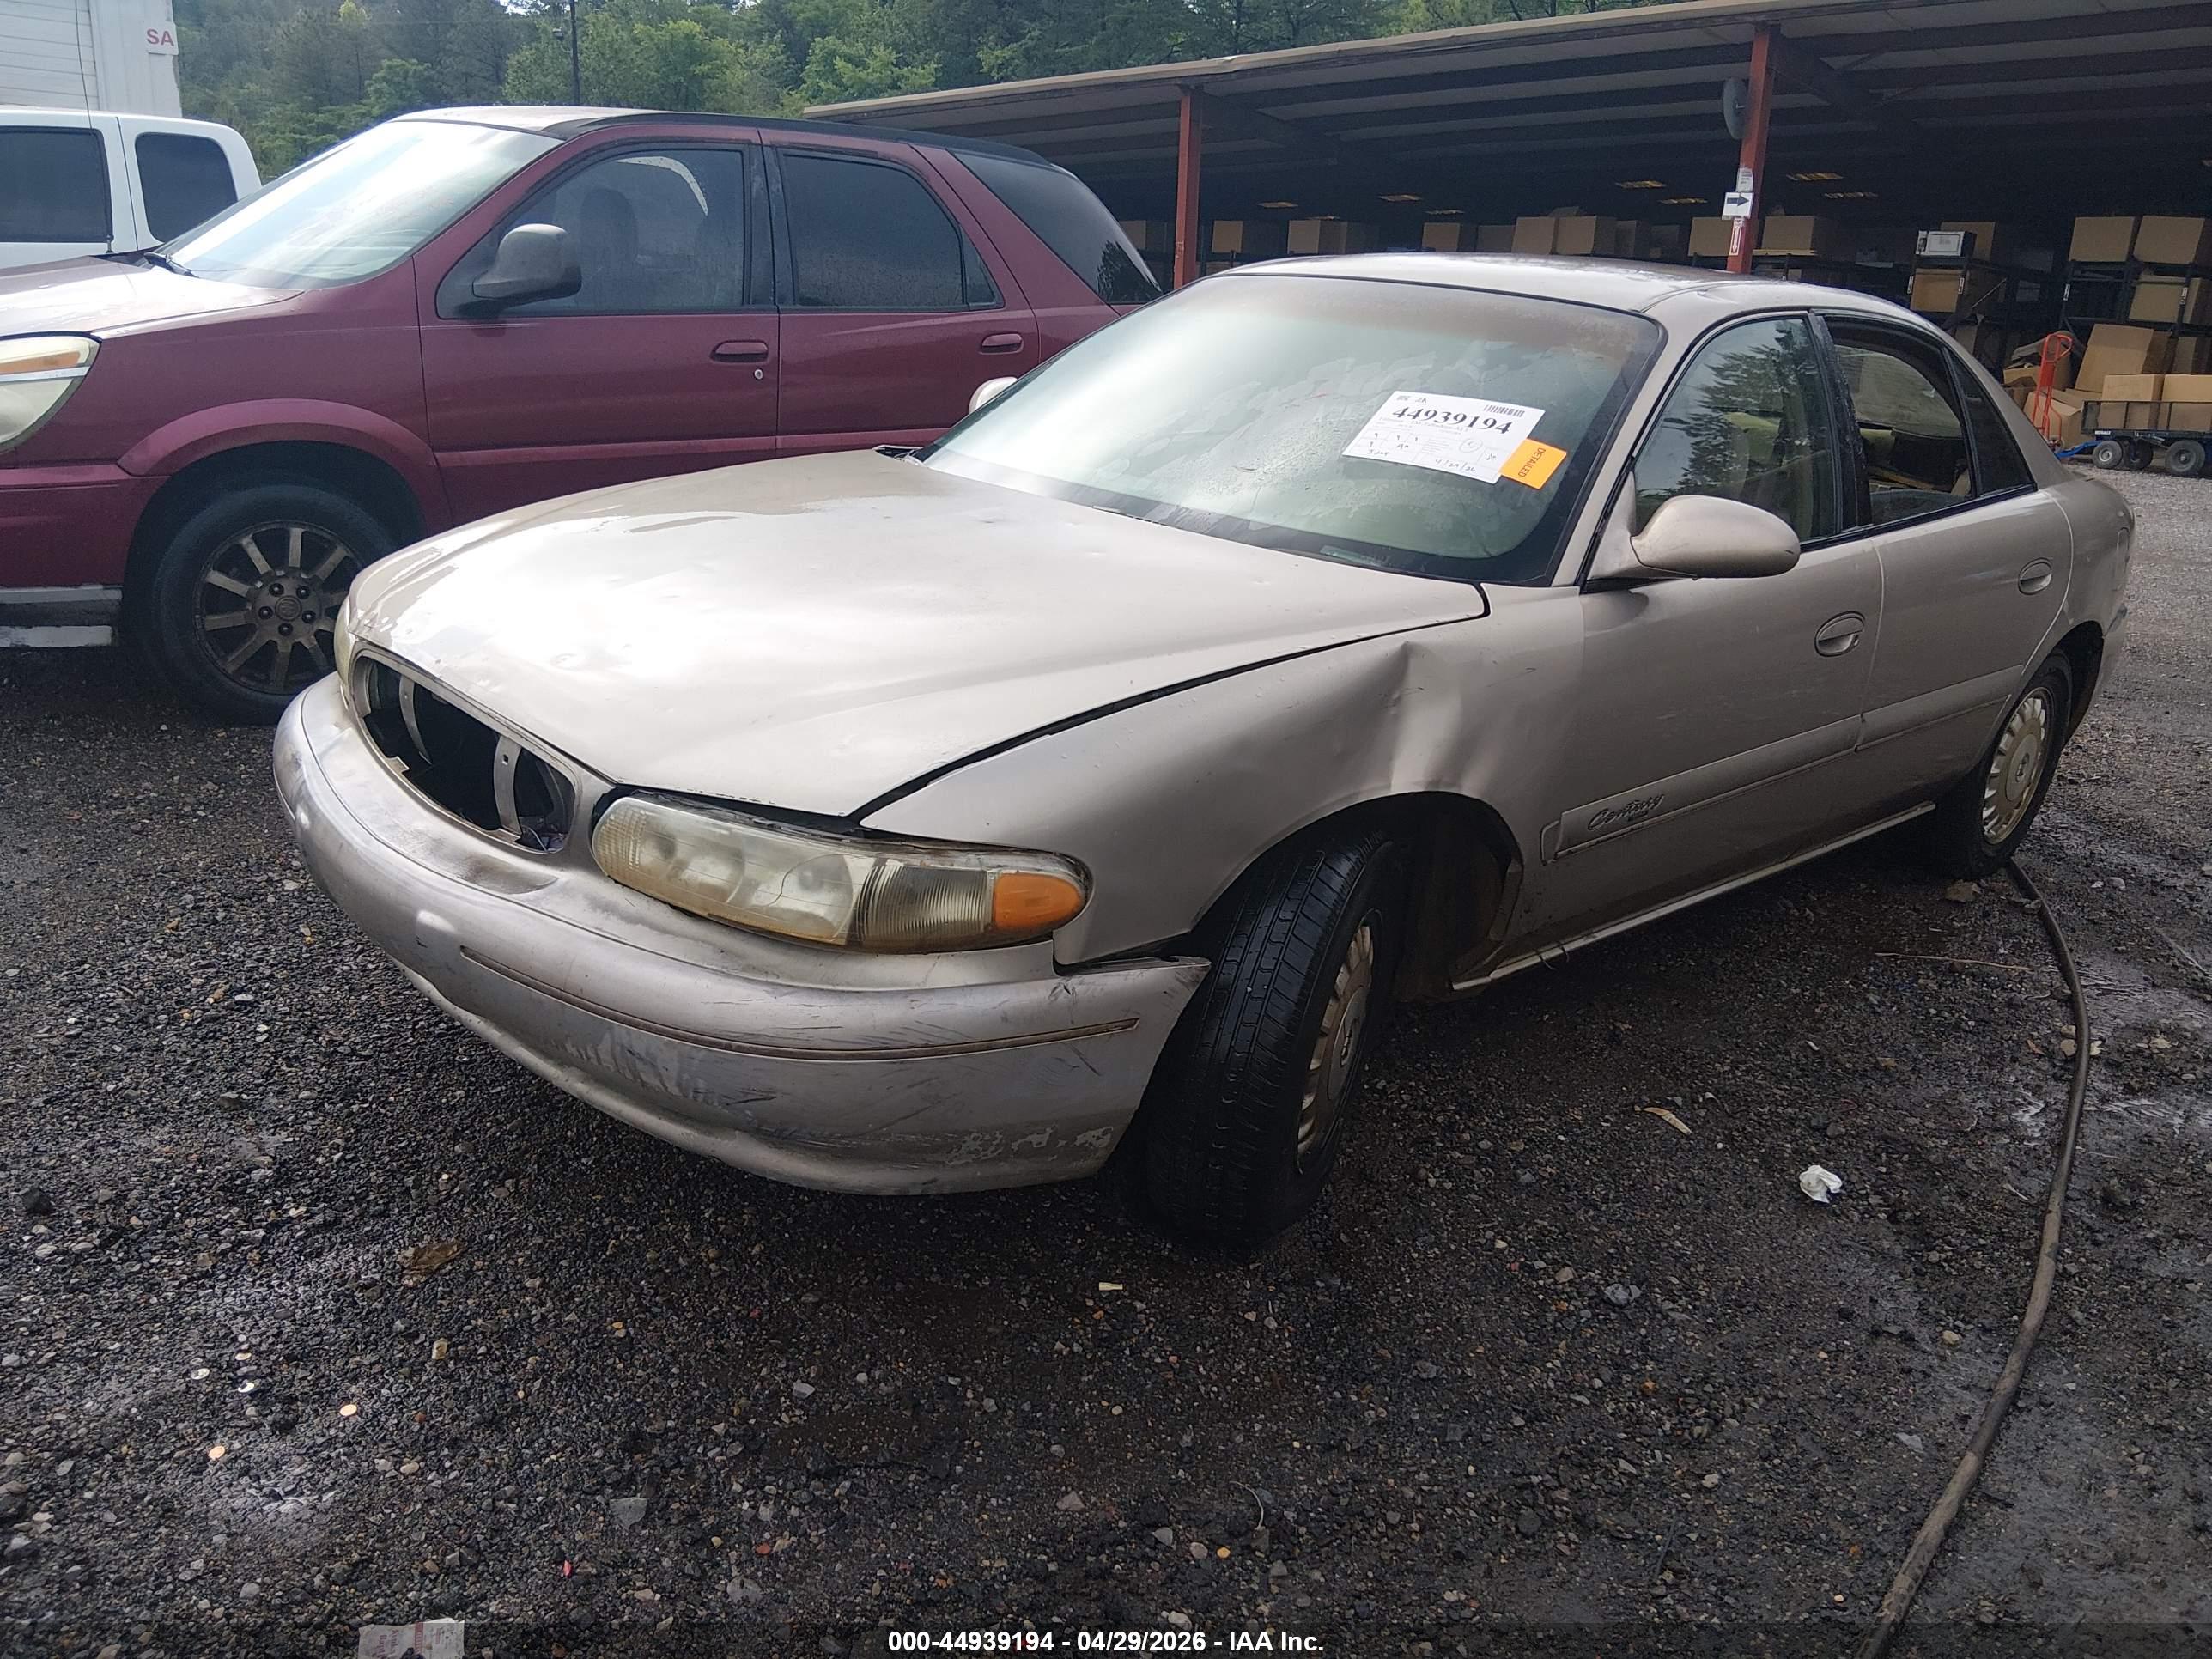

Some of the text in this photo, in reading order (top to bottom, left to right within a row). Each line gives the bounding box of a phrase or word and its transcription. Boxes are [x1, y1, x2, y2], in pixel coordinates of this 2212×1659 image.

[146, 28, 174, 46] SA
[1392, 406, 1513, 434] 44939194
[1518, 447, 1547, 477] DETAILED
[1587, 794, 1664, 830] Century
